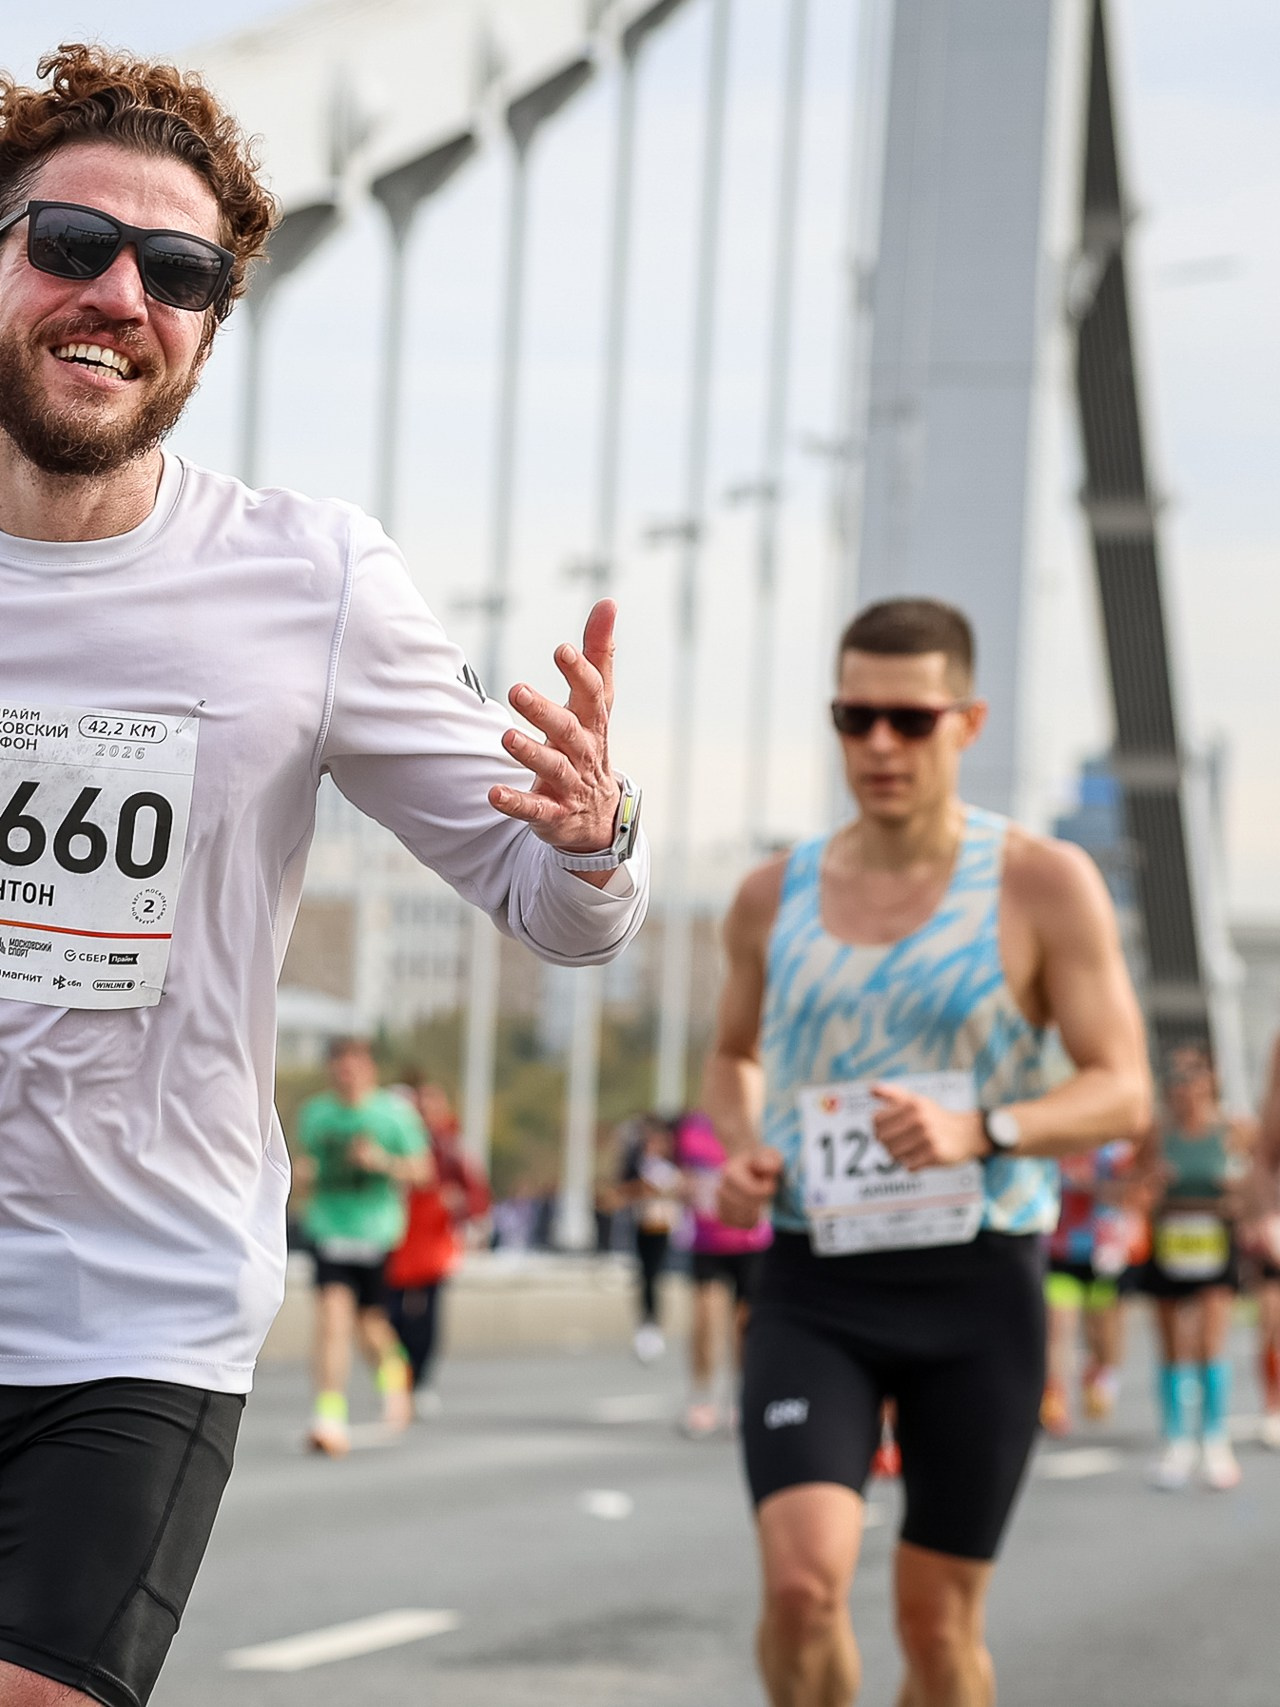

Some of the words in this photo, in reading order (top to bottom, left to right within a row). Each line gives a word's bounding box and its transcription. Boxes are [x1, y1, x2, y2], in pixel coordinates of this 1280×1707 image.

[88, 720, 125, 736] 42,2
[129, 722, 157, 738] КМ
[95, 744, 146, 760] 2026
[143, 899, 155, 913] 2
[8, 938, 53, 952] МОСКОВСКИЙ
[8, 947, 29, 958] СПОРТ
[78, 953, 107, 963] СБЕР
